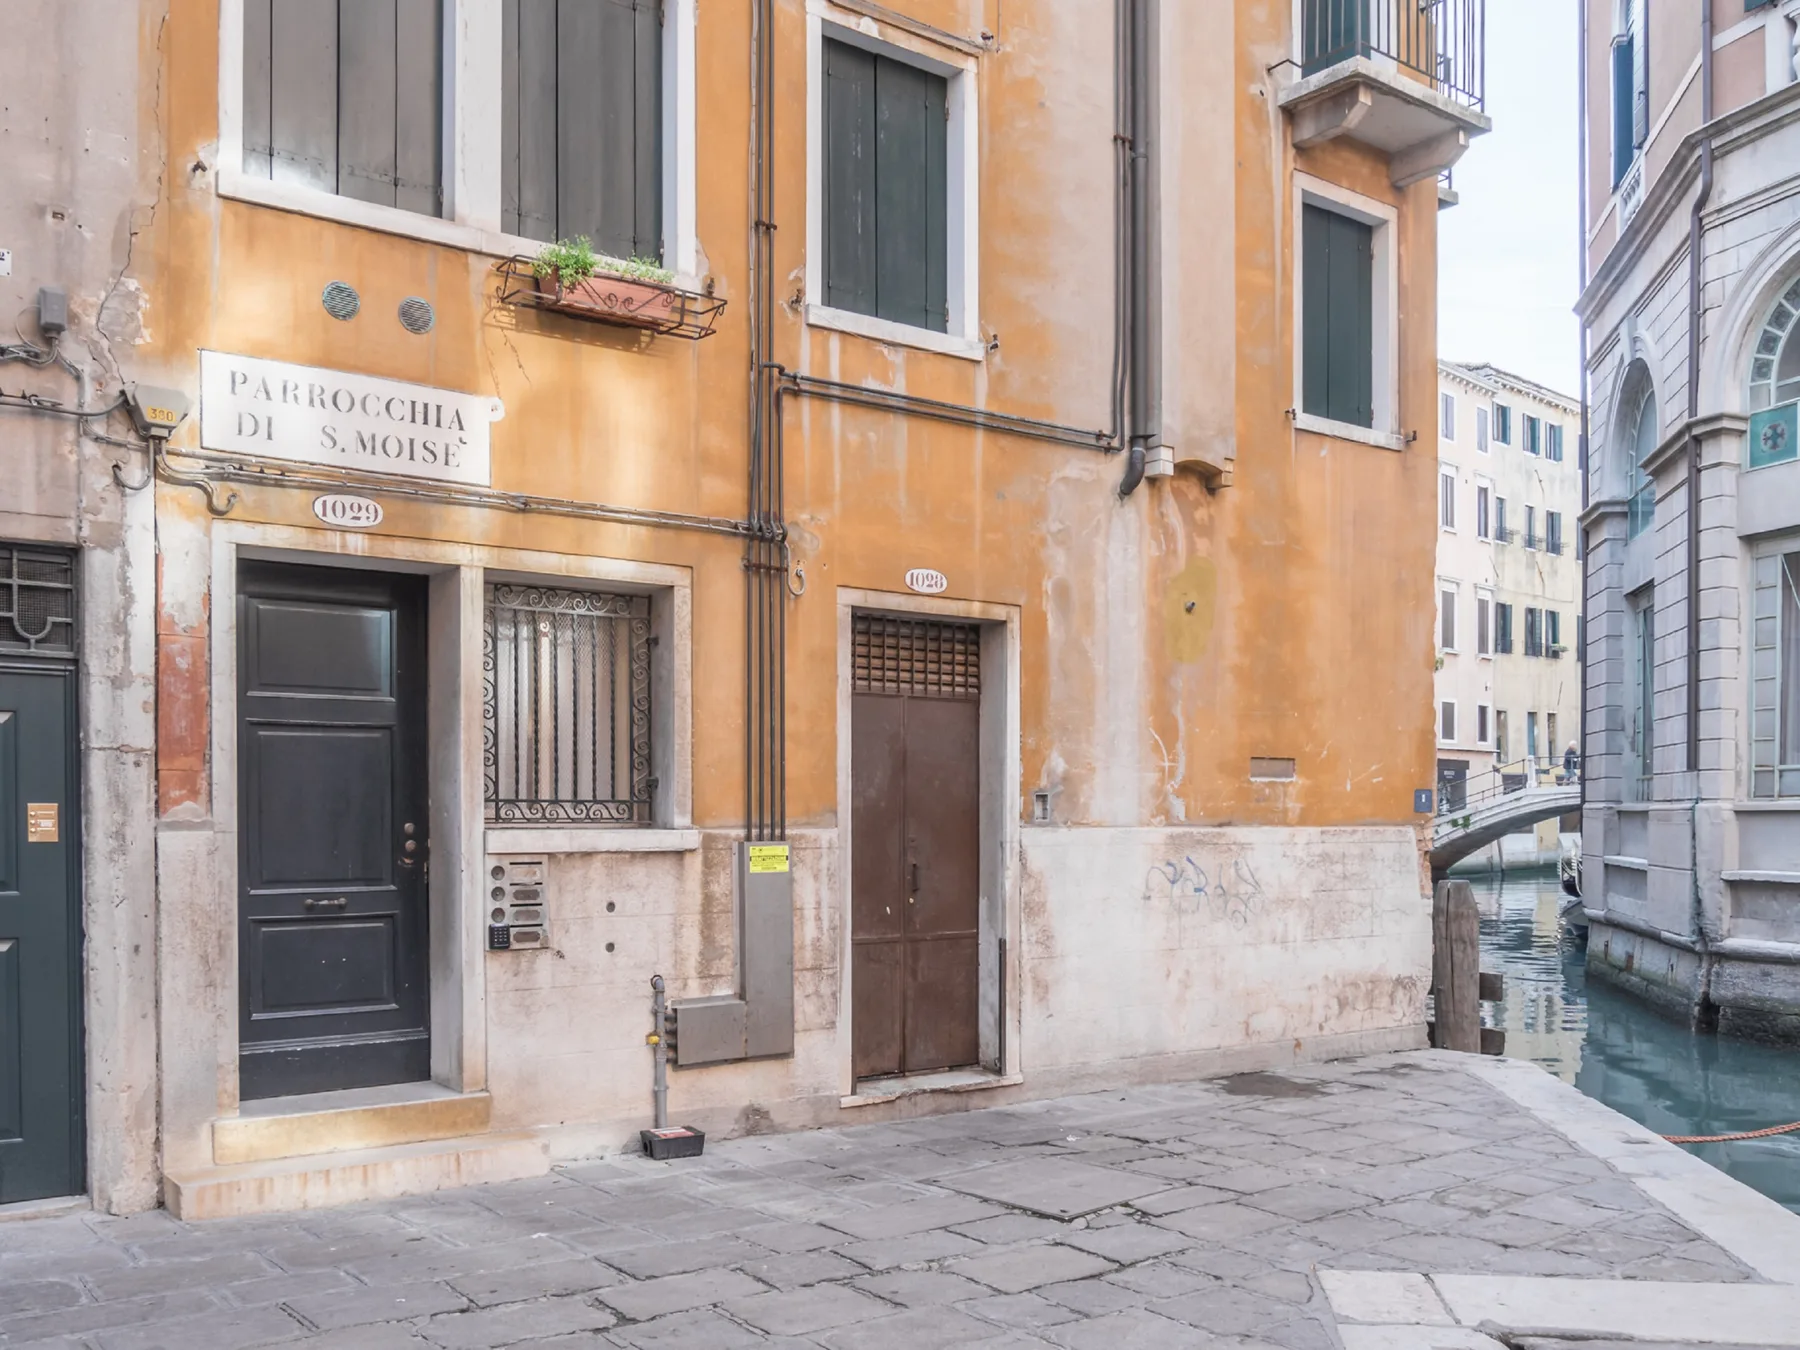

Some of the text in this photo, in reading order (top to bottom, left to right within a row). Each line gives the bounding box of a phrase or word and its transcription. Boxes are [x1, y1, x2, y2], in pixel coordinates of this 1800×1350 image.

[229, 370, 465, 431] PARROCCHIA
[237, 411, 273, 441] DI
[321, 499, 379, 523] 1029
[909, 572, 943, 589] 1028
